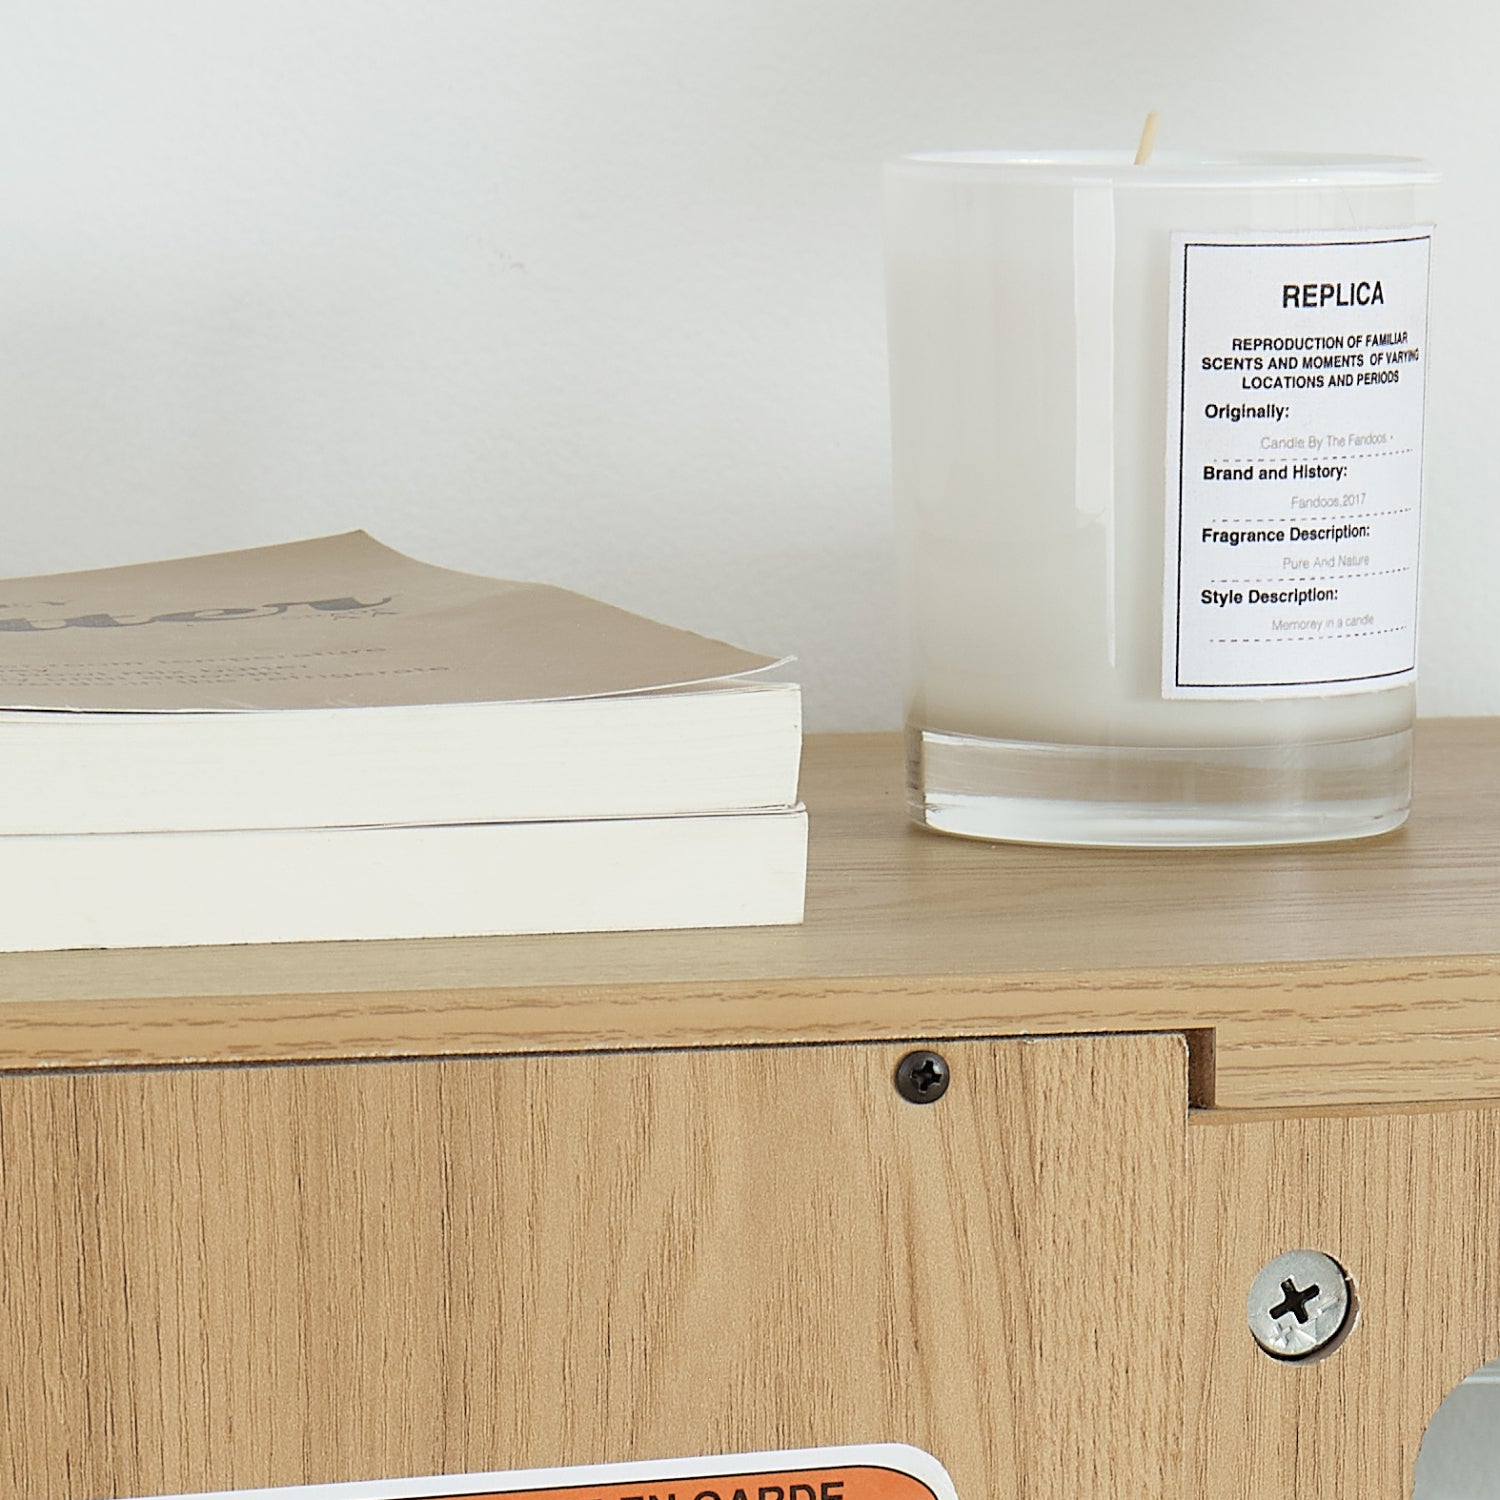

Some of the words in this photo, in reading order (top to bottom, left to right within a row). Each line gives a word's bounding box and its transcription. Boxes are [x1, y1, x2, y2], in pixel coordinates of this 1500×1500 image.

[1282, 280, 1385, 309] REPLICA
[1231, 335, 1344, 351] REPRODUCTION
[1346, 334, 1363, 349] OF
[1365, 331, 1408, 348] FAMILIAR
[1201, 356, 1264, 371] SCENTS
[1267, 356, 1299, 371] AND
[1302, 353, 1364, 370] MOMENTS
[1369, 352, 1384, 366] OF
[1385, 347, 1419, 365] VARYING
[1241, 374, 1325, 390] LOCATIONS
[1327, 373, 1354, 388] AND
[1356, 369, 1400, 387] PERIODS
[1204, 403, 1290, 423] Originally:
[1203, 465, 1254, 481] Brand
[1258, 465, 1288, 481] and
[1292, 462, 1348, 481] History:
[1201, 527, 1285, 547] Fragrance
[1289, 523, 1370, 543] Description:
[1282, 557, 1310, 570] Pure
[1313, 556, 1336, 568] And
[1338, 554, 1370, 567] Nature
[1200, 589, 1243, 608] Style
[1248, 586, 1338, 606] Description:
